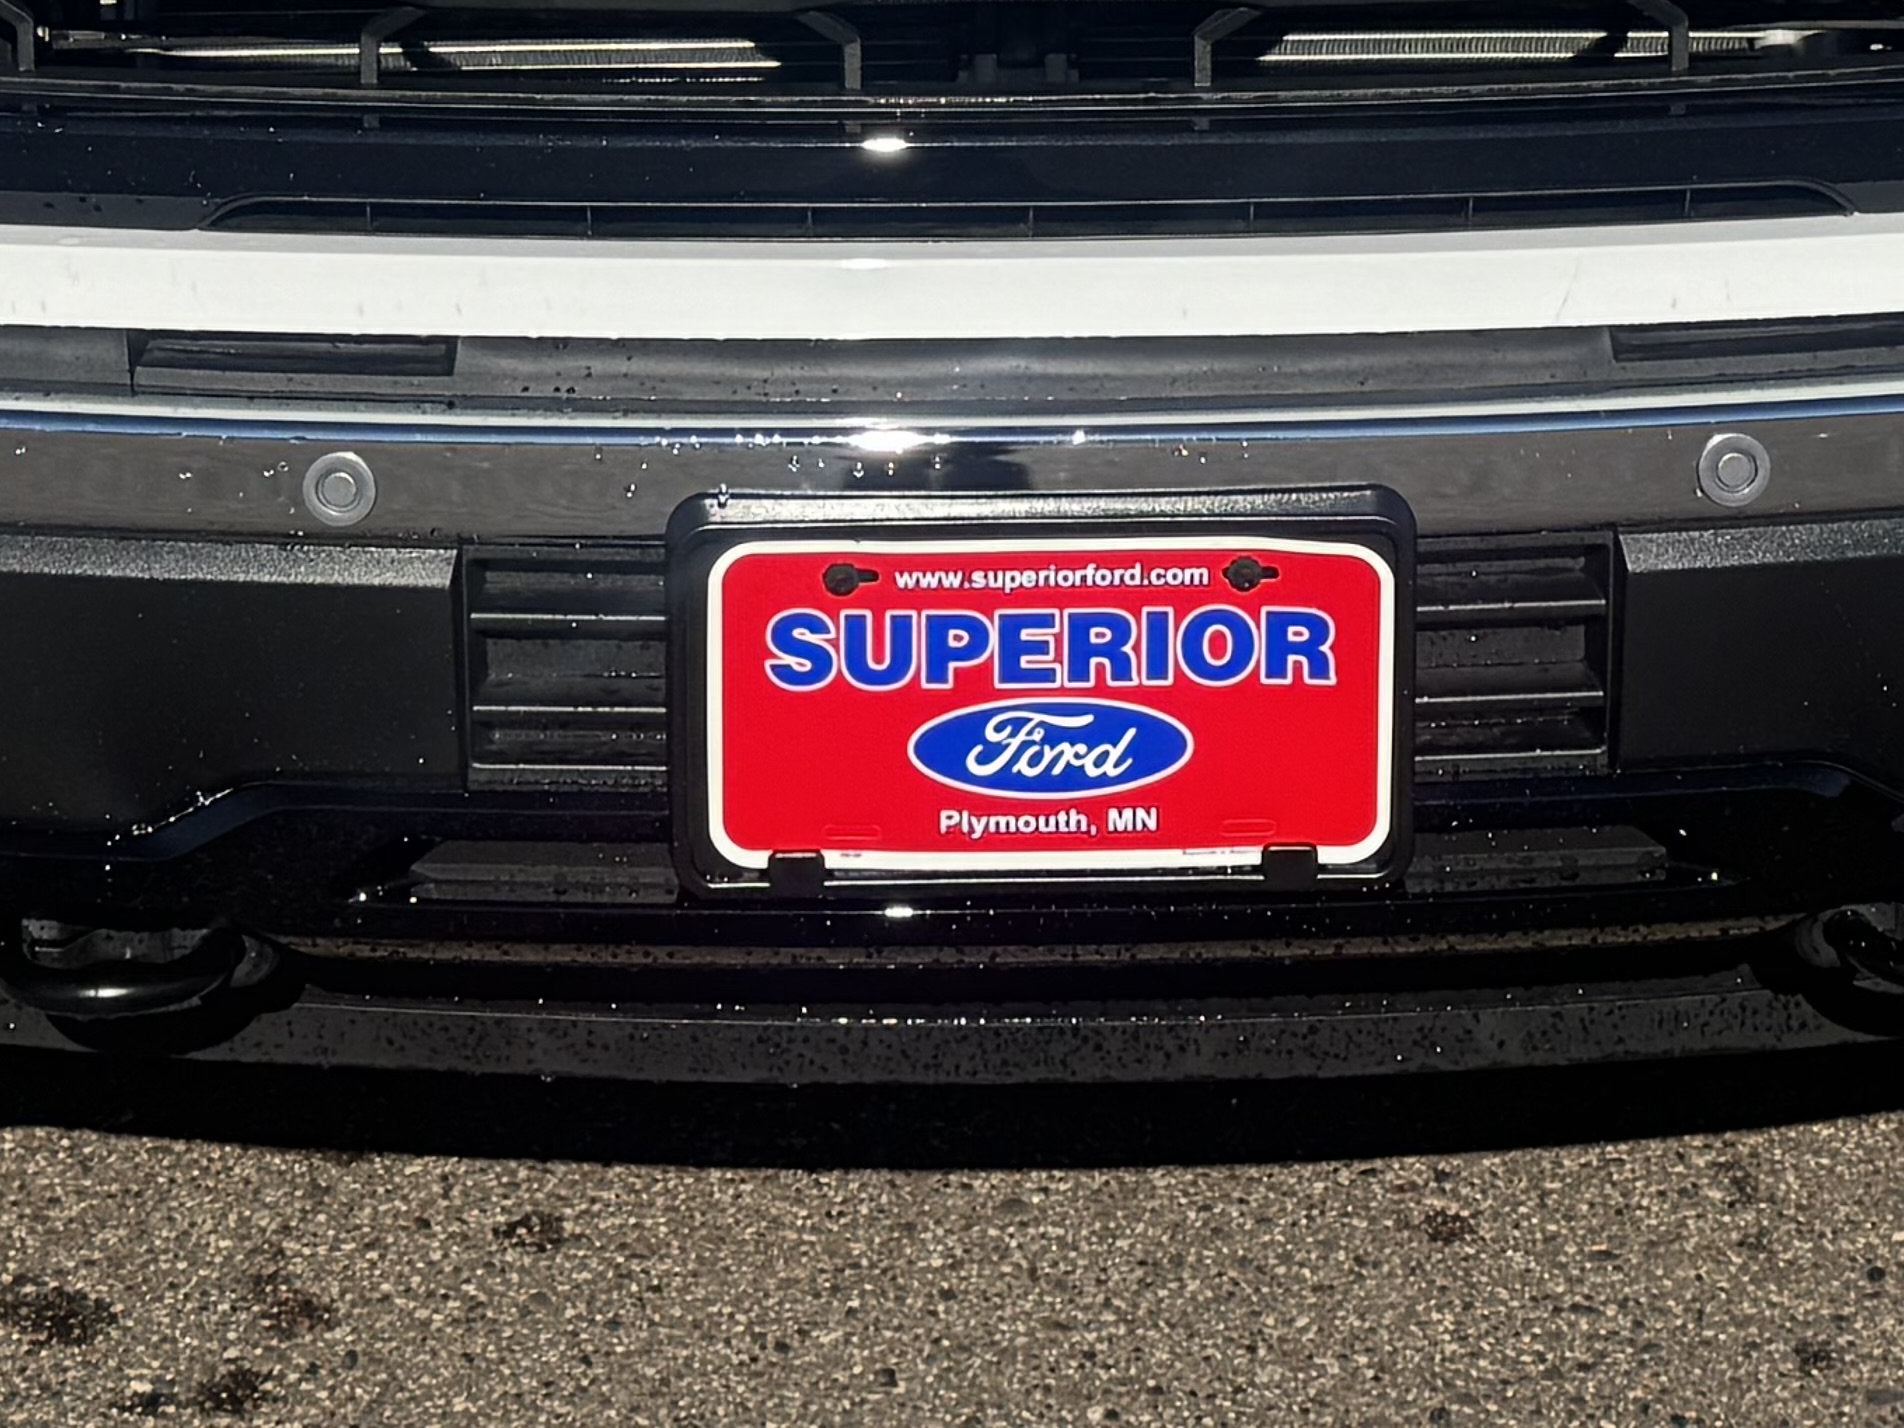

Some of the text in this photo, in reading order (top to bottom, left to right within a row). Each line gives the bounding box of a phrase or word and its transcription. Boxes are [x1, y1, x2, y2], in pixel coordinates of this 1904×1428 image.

[894, 562, 1210, 594] www.superiorford.com
[765, 605, 1337, 691] SUPERIOR
[965, 710, 1137, 779] Ford
[938, 807, 1159, 841] Plymouth, MN
